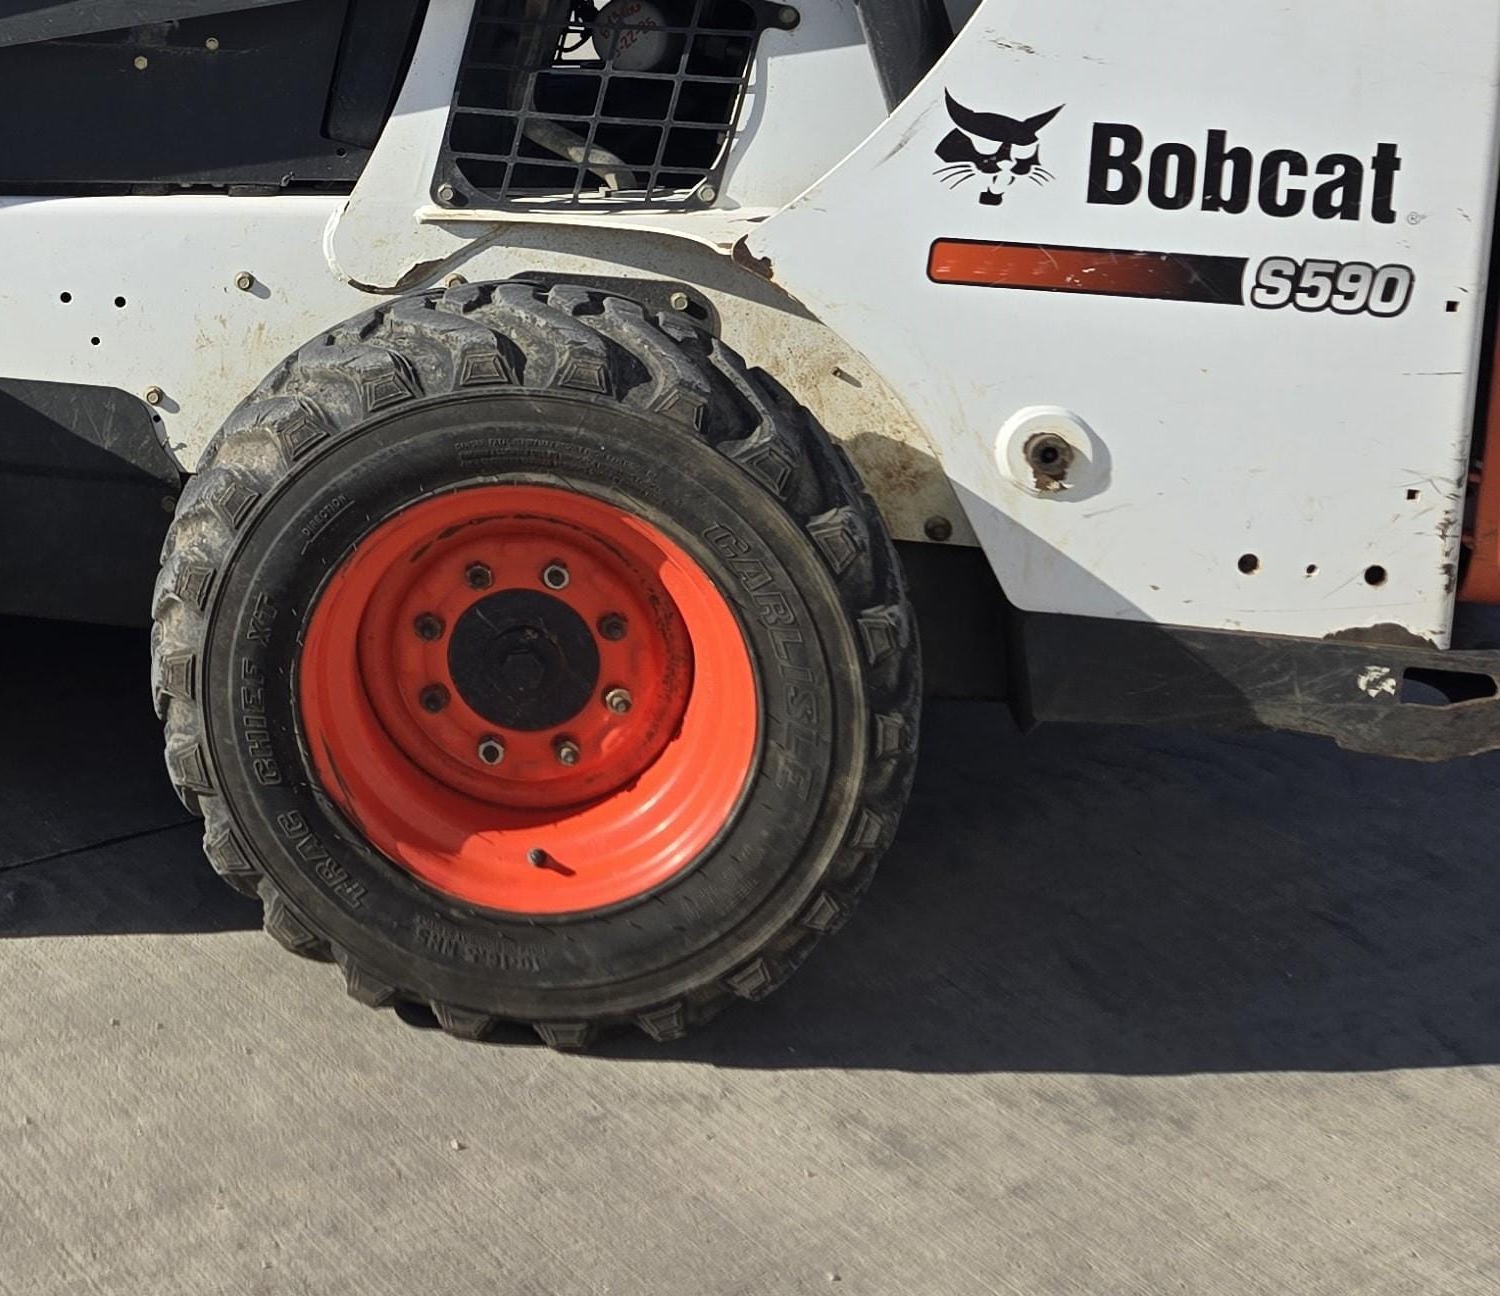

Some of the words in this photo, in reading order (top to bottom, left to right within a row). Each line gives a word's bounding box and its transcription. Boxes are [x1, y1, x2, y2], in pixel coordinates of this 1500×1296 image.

[1086, 122, 1402, 224] Bobcat
[1250, 255, 1415, 318] S590
[301, 494, 348, 537] DIRECTION
[247, 591, 280, 646] XT
[701, 522, 820, 799] CARLISLE
[241, 657, 282, 786] CHIEF
[278, 810, 369, 910] TRAC
